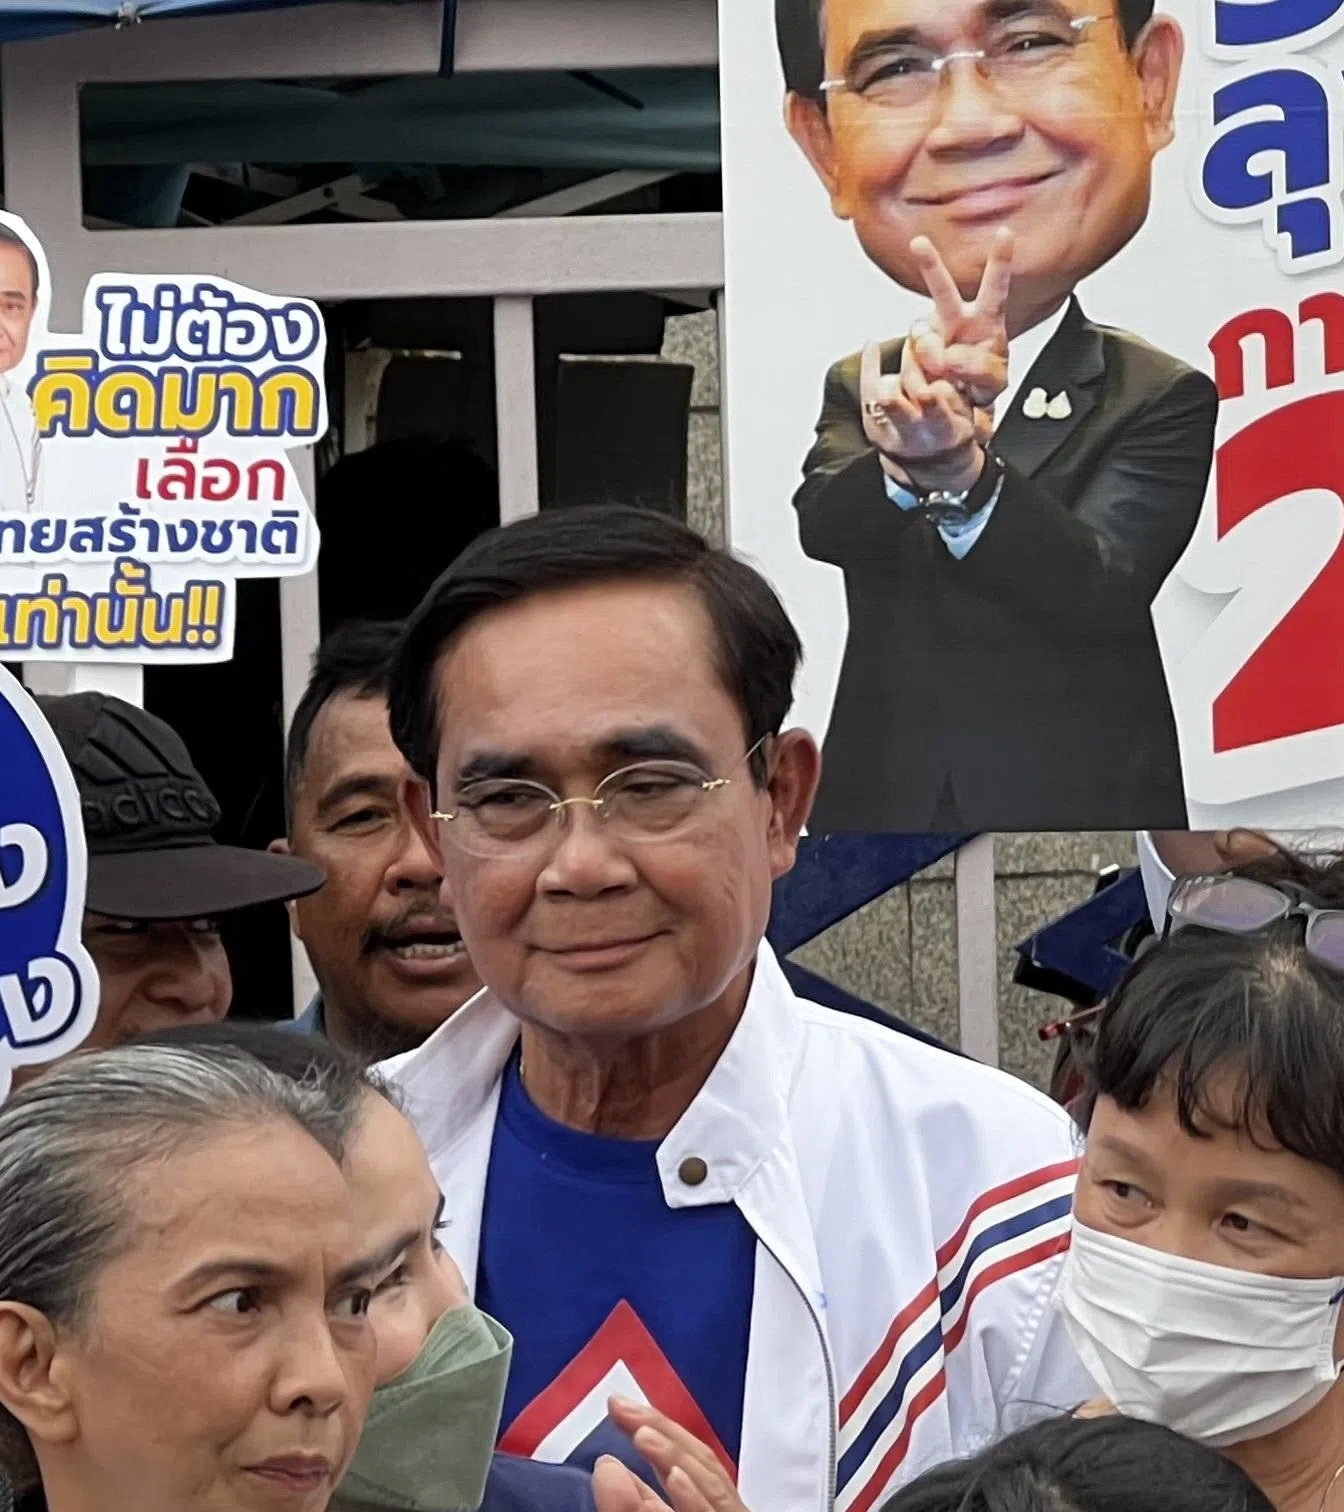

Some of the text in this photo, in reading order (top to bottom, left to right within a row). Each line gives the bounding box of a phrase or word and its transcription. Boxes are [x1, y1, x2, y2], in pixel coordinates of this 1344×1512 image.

[96, 287, 318, 360] ไม่ต้อง
[28, 350, 320, 436] คิดมาก
[137, 438, 286, 501] เลือก
